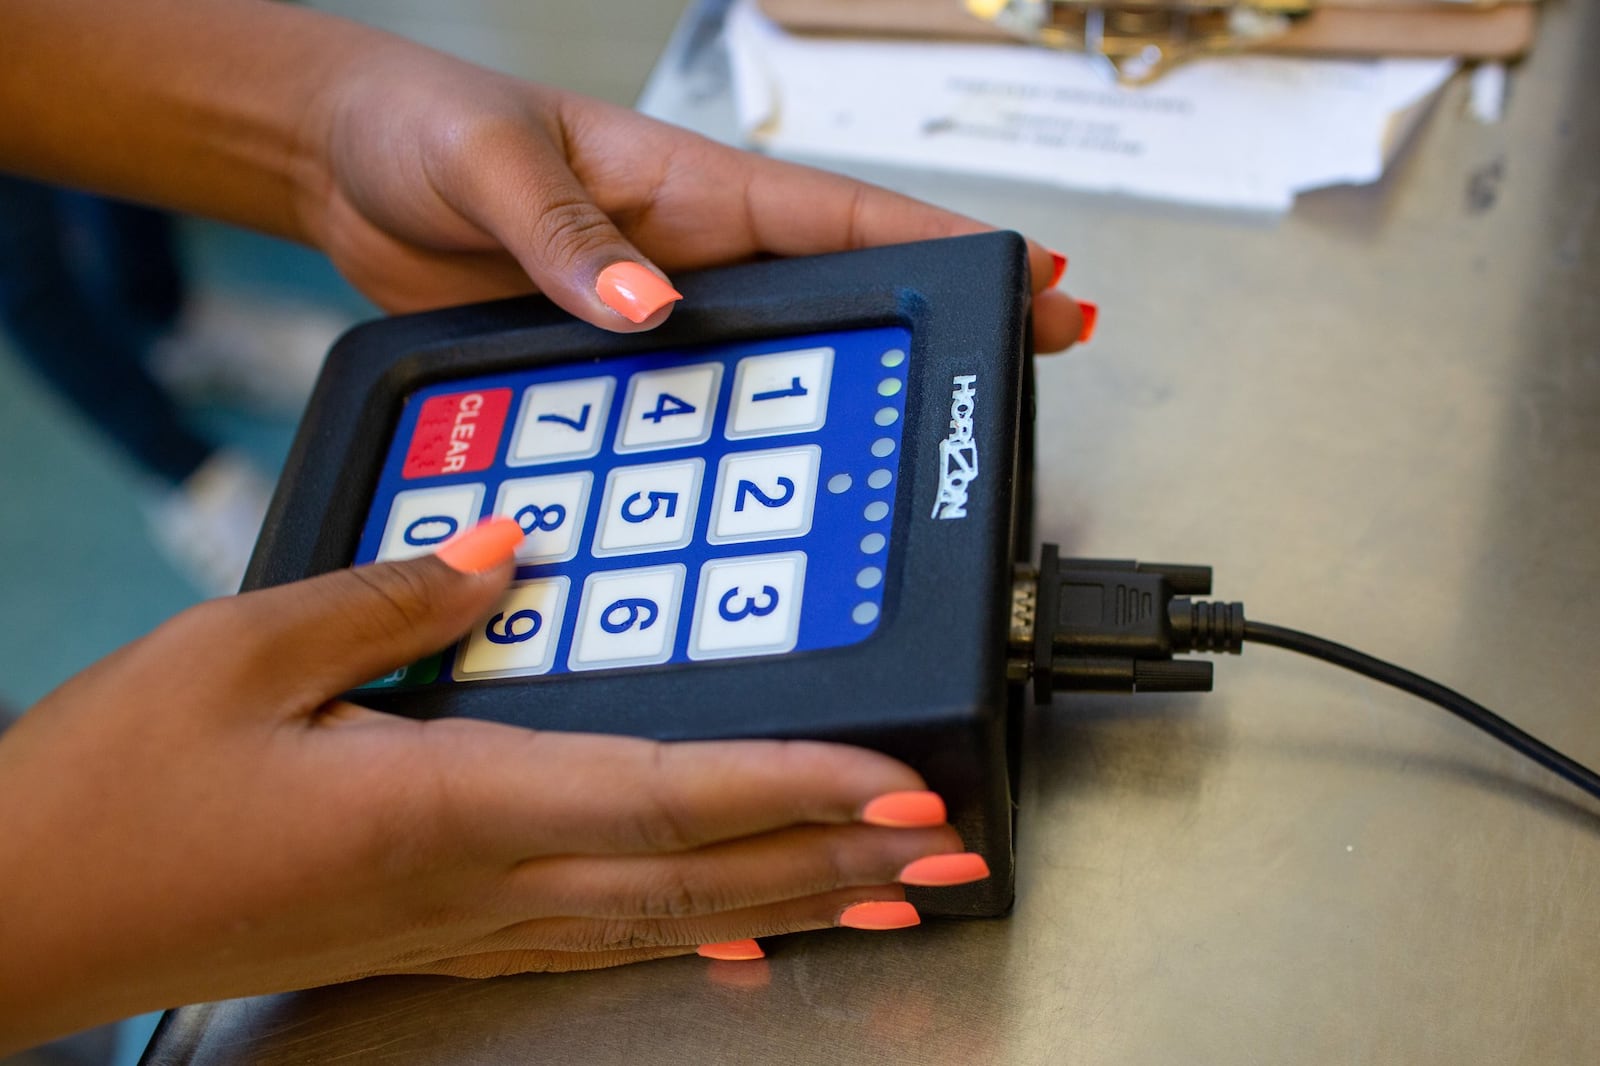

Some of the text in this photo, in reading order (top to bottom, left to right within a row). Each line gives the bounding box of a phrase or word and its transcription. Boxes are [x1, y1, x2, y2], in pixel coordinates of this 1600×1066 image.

[751, 376, 808, 402] 1
[537, 403, 591, 433] 7
[642, 392, 697, 424] 4
[441, 393, 484, 474] CLEAR
[620, 490, 679, 524] 5
[734, 476, 795, 513] 2
[403, 515, 458, 546] 0
[514, 503, 567, 536] 8
[600, 597, 659, 634] 6
[718, 585, 780, 622] 3
[485, 609, 543, 645] 9
